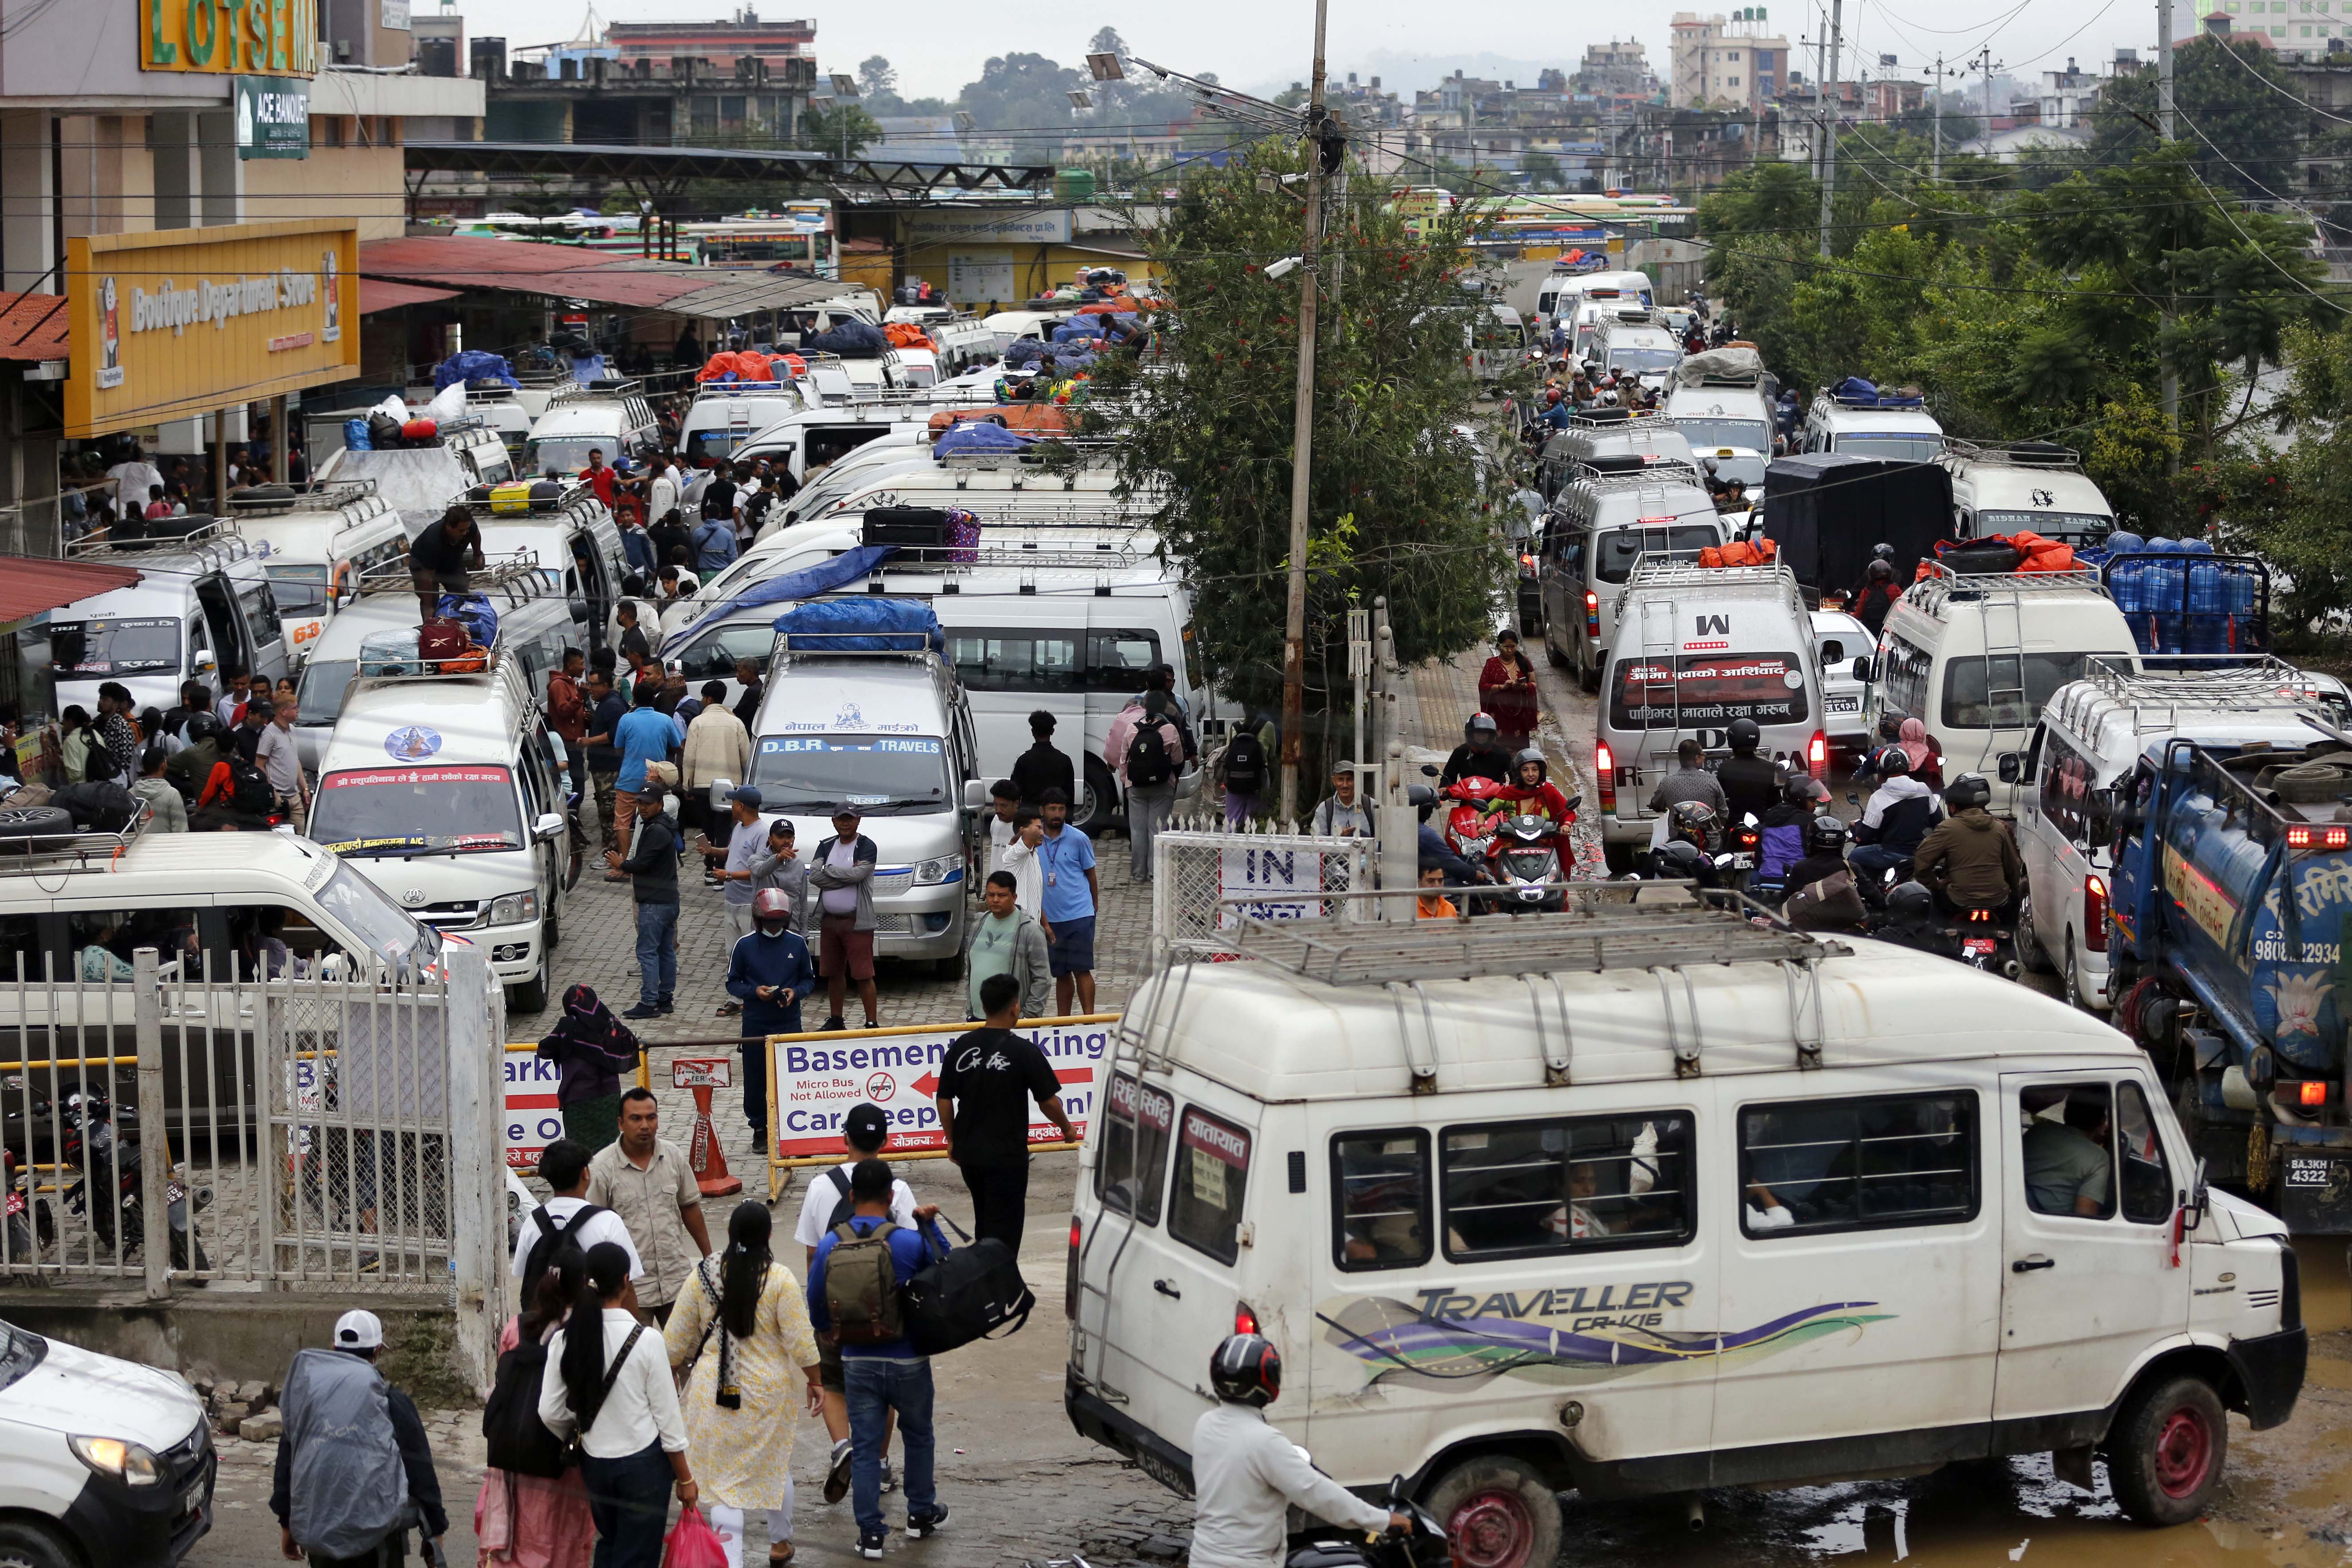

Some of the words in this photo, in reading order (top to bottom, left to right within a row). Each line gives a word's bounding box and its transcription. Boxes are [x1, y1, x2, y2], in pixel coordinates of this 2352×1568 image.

[257, 93, 274, 123] ACE
[276, 93, 307, 124] BANQUET
[131, 278, 199, 336] Boutique
[198, 275, 278, 329] Department
[279, 267, 316, 307] Store
[294, 622, 320, 645] 63
[1682, 704, 1724, 719] माताले
[1726, 705, 1752, 718] रक्षा
[784, 722, 826, 731] नेपाल
[762, 739, 823, 753] D.B.R
[879, 740, 940, 754] TRAVELS
[337, 777, 348, 787] श्री
[350, 773, 395, 786] पशुपतिनाथ
[398, 773, 407, 783] ले
[422, 773, 439, 782] हामी
[464, 773, 480, 782] रक्षा
[1246, 849, 1294, 885] IN
[797, 1081, 828, 1089] Micro
[832, 1079, 854, 1087] Bus
[790, 1092, 811, 1101] Not
[814, 1089, 861, 1100] Allowed
[892, 1134, 934, 1147] सौजन्य:
[1188, 1114, 1246, 1158] यातायात
[2291, 1160, 2328, 1169] BA.3KH
[2291, 1170, 2326, 1182] 4322
[1417, 1282, 1693, 1325] TRAVELLER
